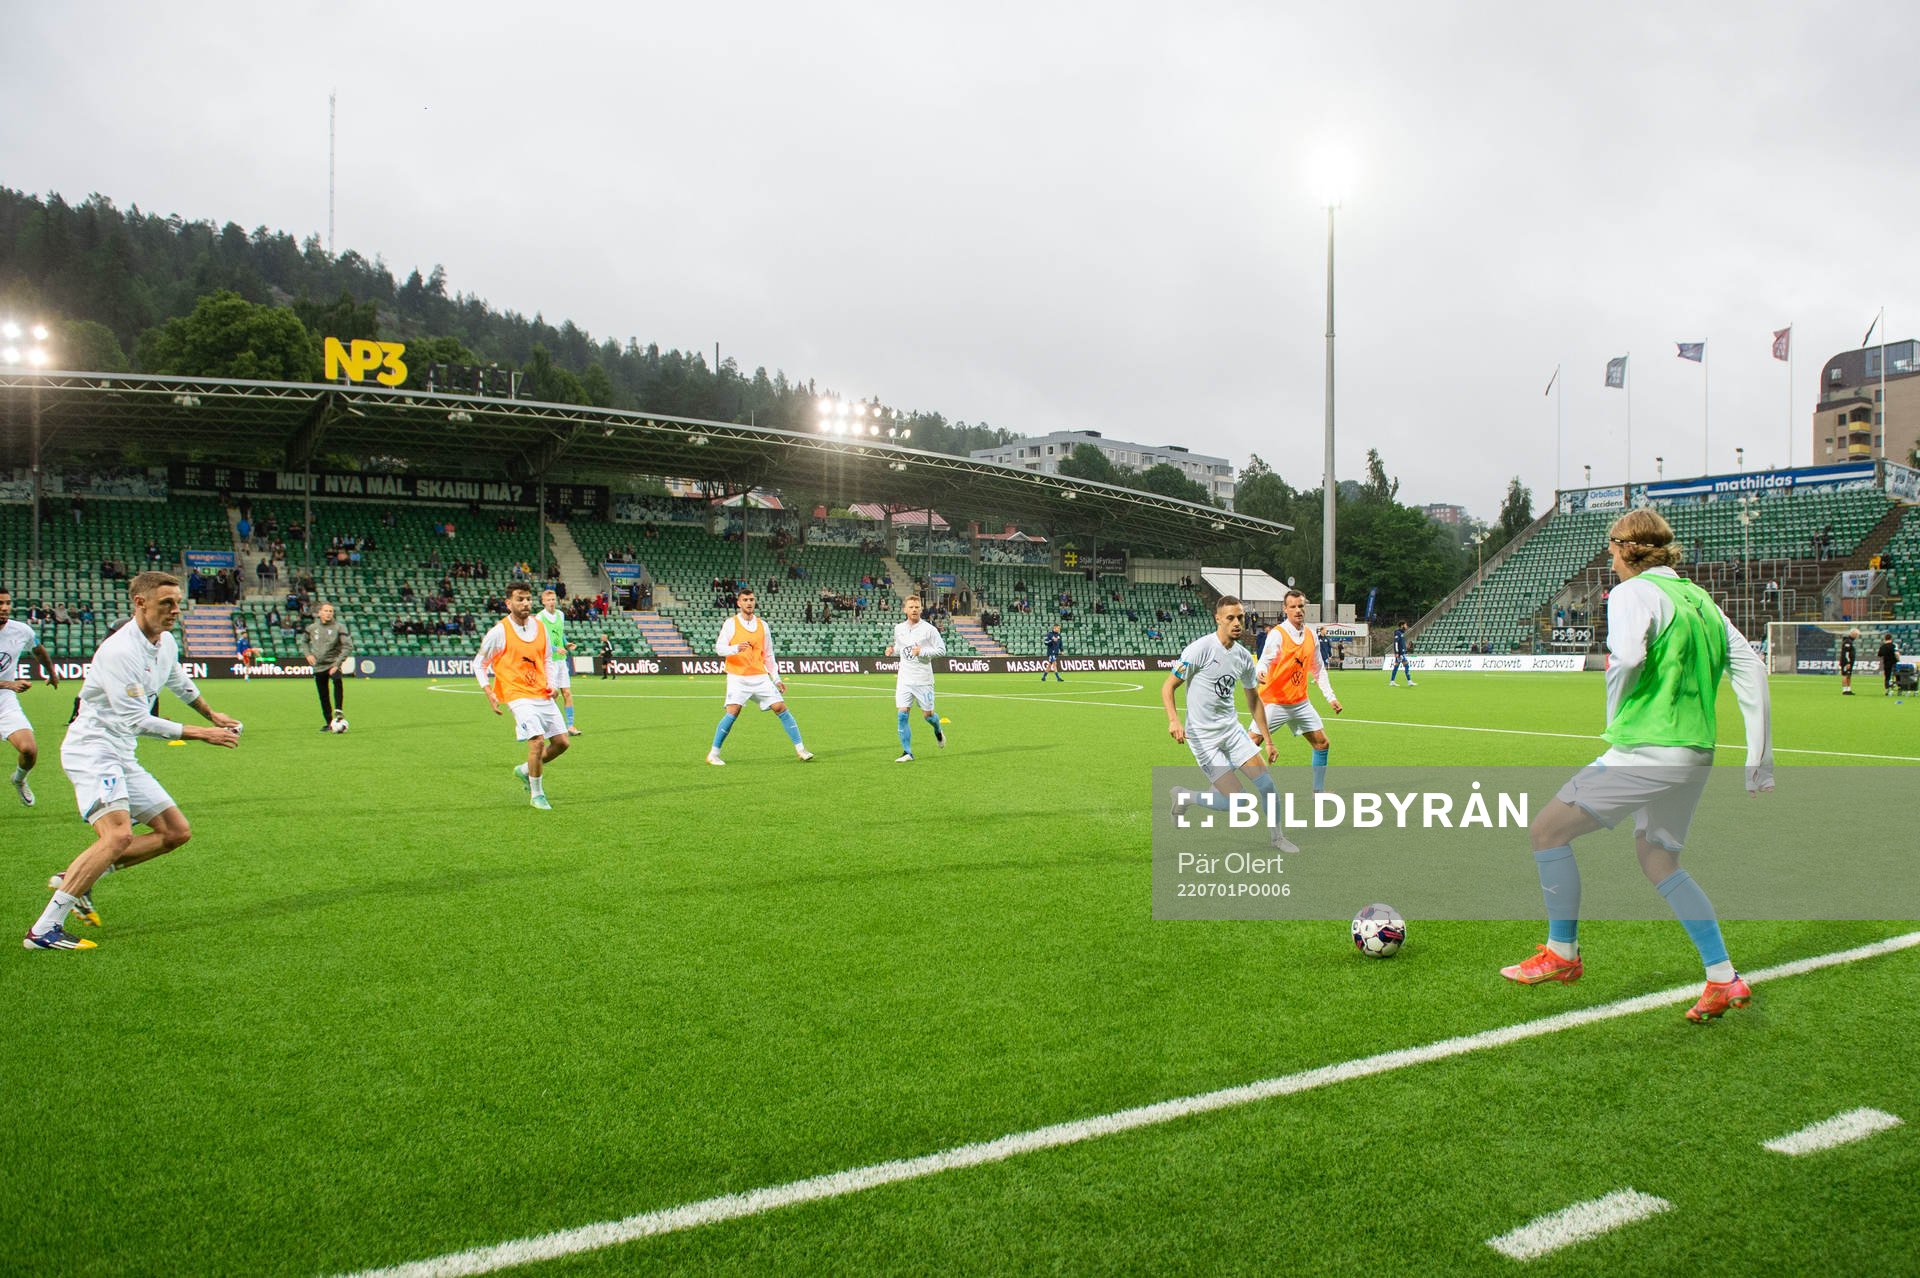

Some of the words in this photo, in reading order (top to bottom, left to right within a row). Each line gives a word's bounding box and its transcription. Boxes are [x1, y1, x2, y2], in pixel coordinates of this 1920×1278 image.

[324, 336, 408, 386] NP3
[276, 472, 319, 491] MOT
[325, 475, 363, 494] NYA
[1715, 474, 1792, 493] mathildas
[1316, 628, 1356, 636] Pradium
[682, 661, 726, 674] MASSA
[799, 660, 860, 673] MATCHEN
[1060, 660, 1096, 671] UNDER
[1097, 660, 1146, 671] MATCHEN
[1433, 658, 1472, 669] knowit
[1482, 658, 1522, 669] knowit
[1532, 658, 1575, 669] knowit
